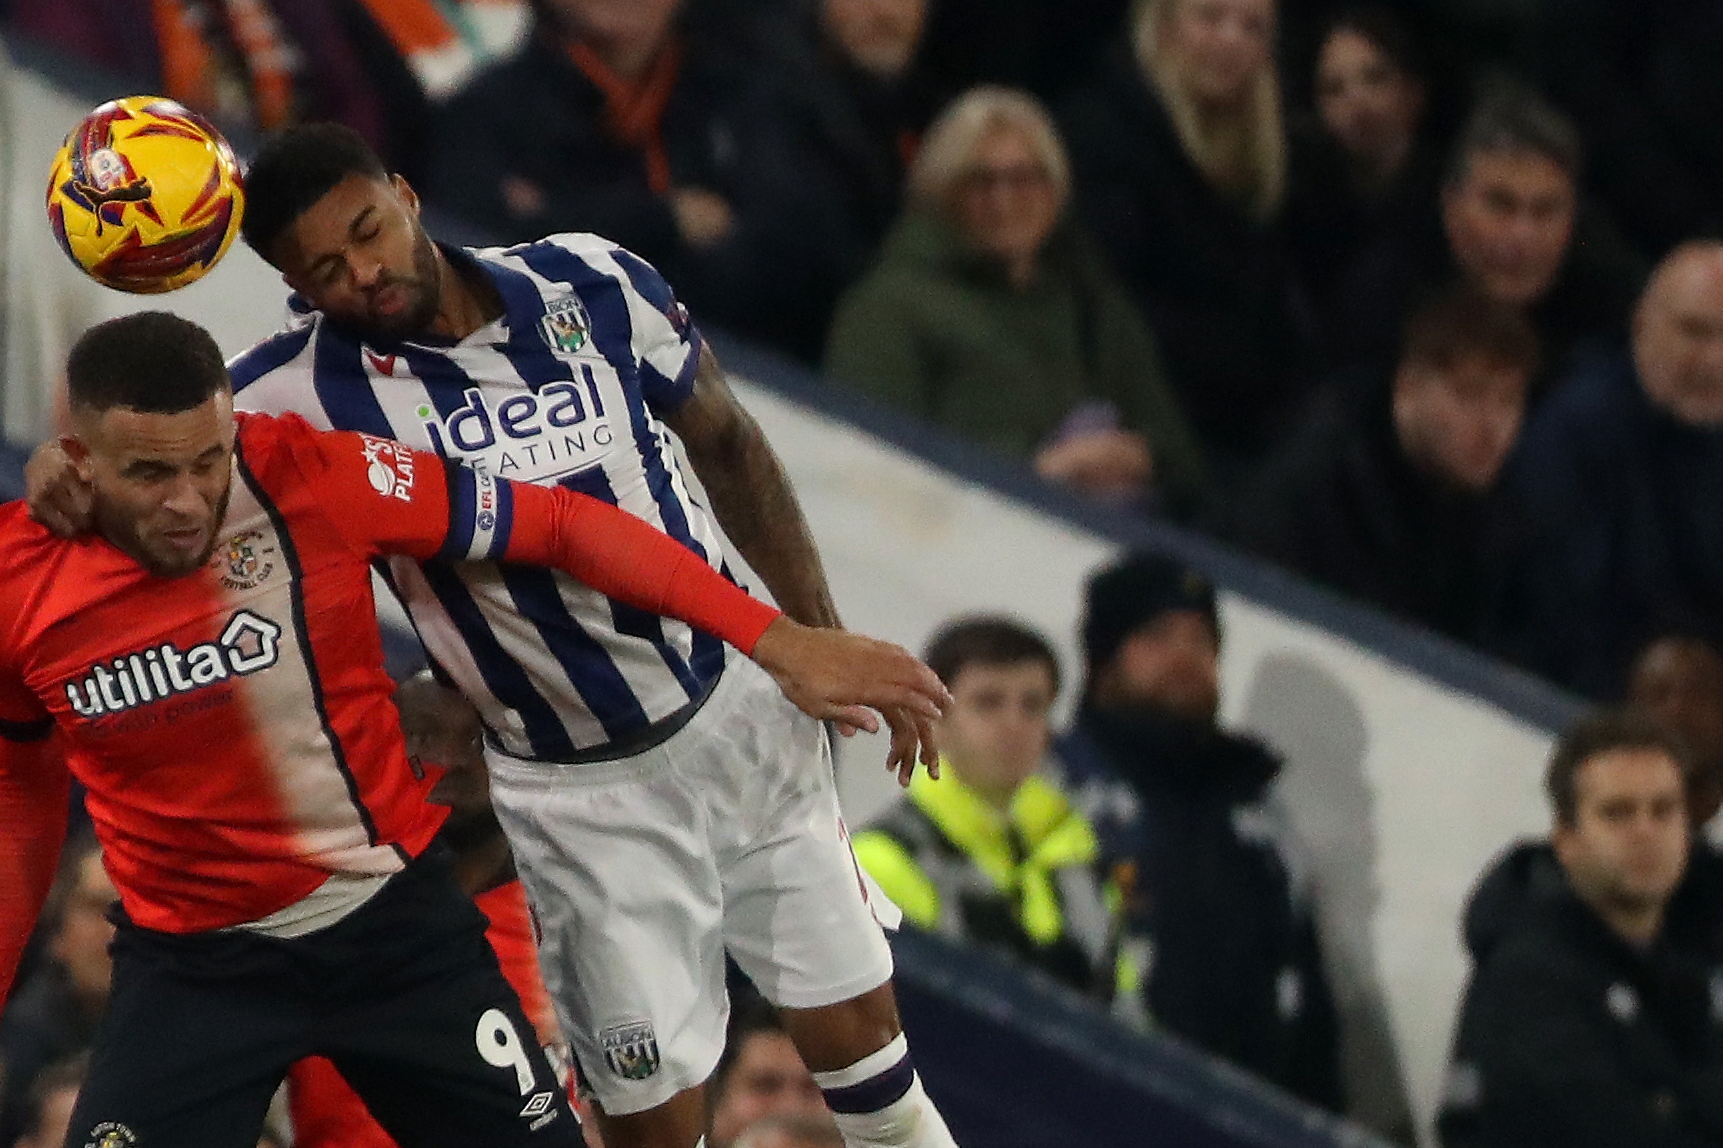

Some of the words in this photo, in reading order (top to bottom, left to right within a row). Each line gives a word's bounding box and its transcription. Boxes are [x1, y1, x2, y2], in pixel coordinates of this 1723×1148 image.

[418, 362, 605, 458] ideal
[390, 440, 415, 502] PLATF
[471, 424, 613, 475] EATING
[67, 644, 227, 715] utilita
[476, 1008, 535, 1096] 9
